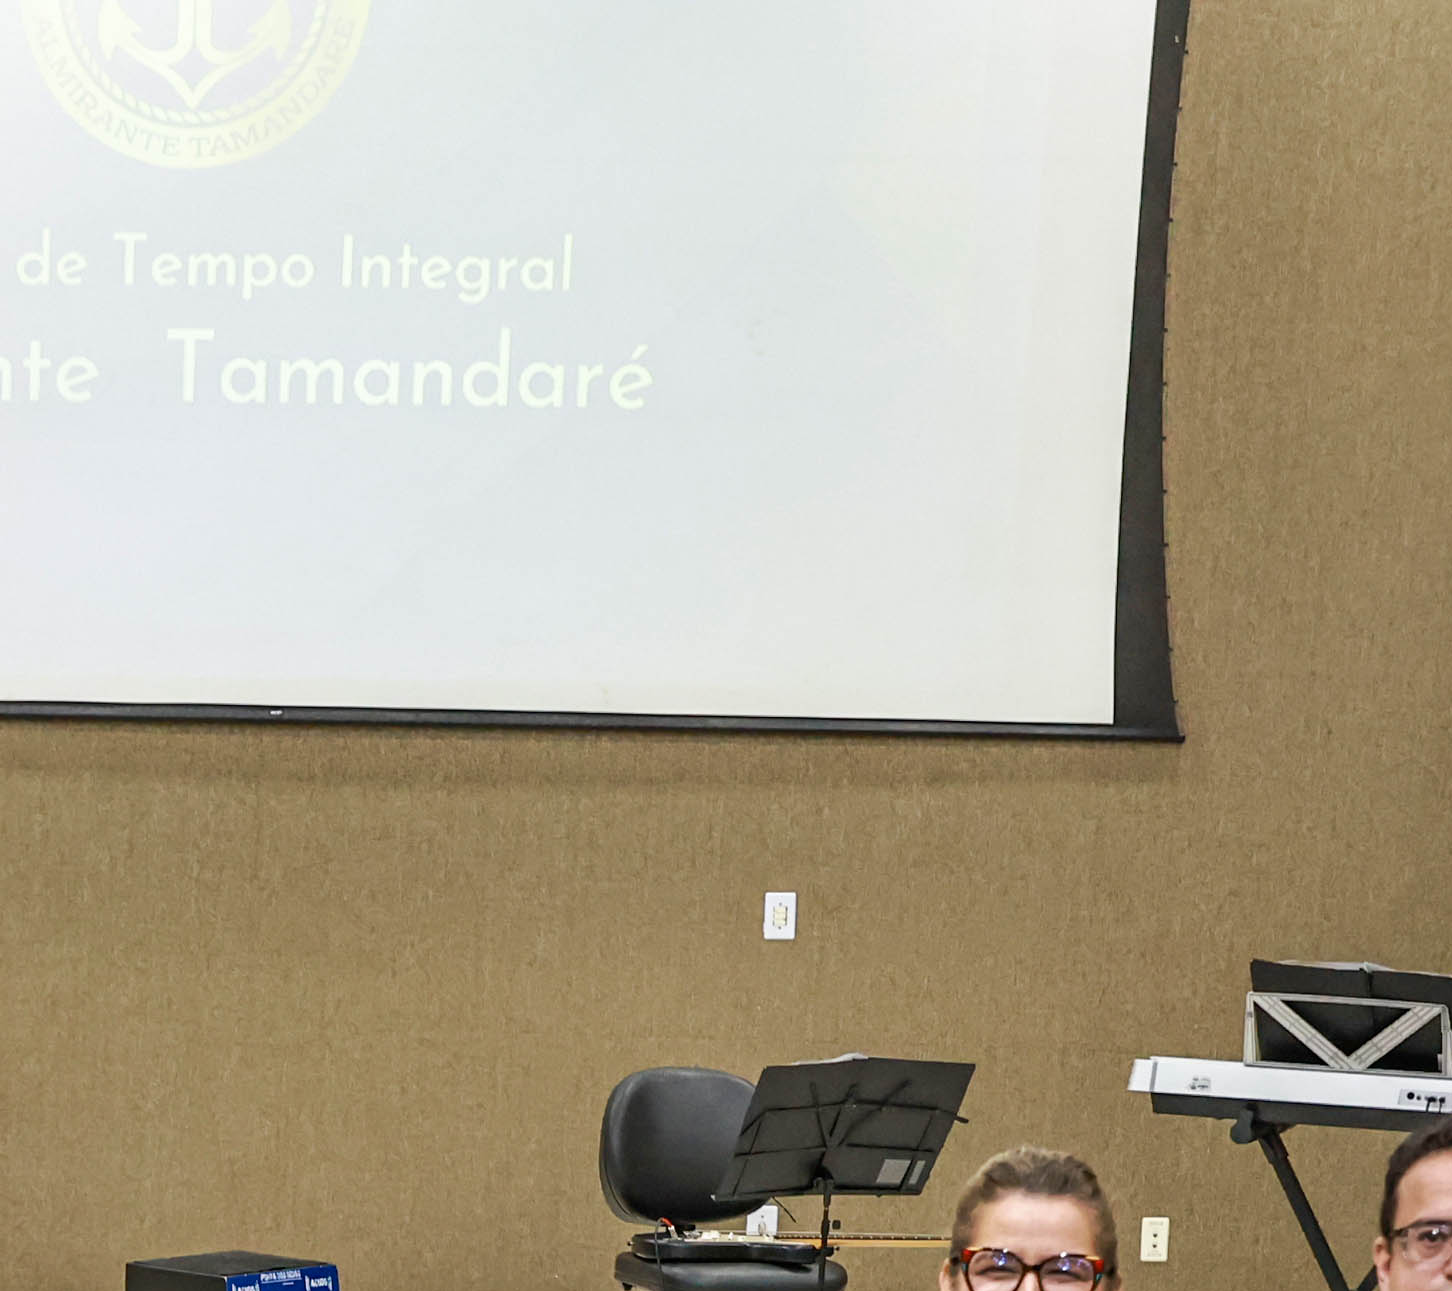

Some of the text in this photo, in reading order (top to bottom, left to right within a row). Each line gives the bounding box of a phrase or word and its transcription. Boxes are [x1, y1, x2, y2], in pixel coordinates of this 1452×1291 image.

[15, 227, 88, 286] de
[113, 231, 315, 301] Tempo
[341, 233, 573, 304] Integral
[167, 327, 654, 410] Tamandaré
